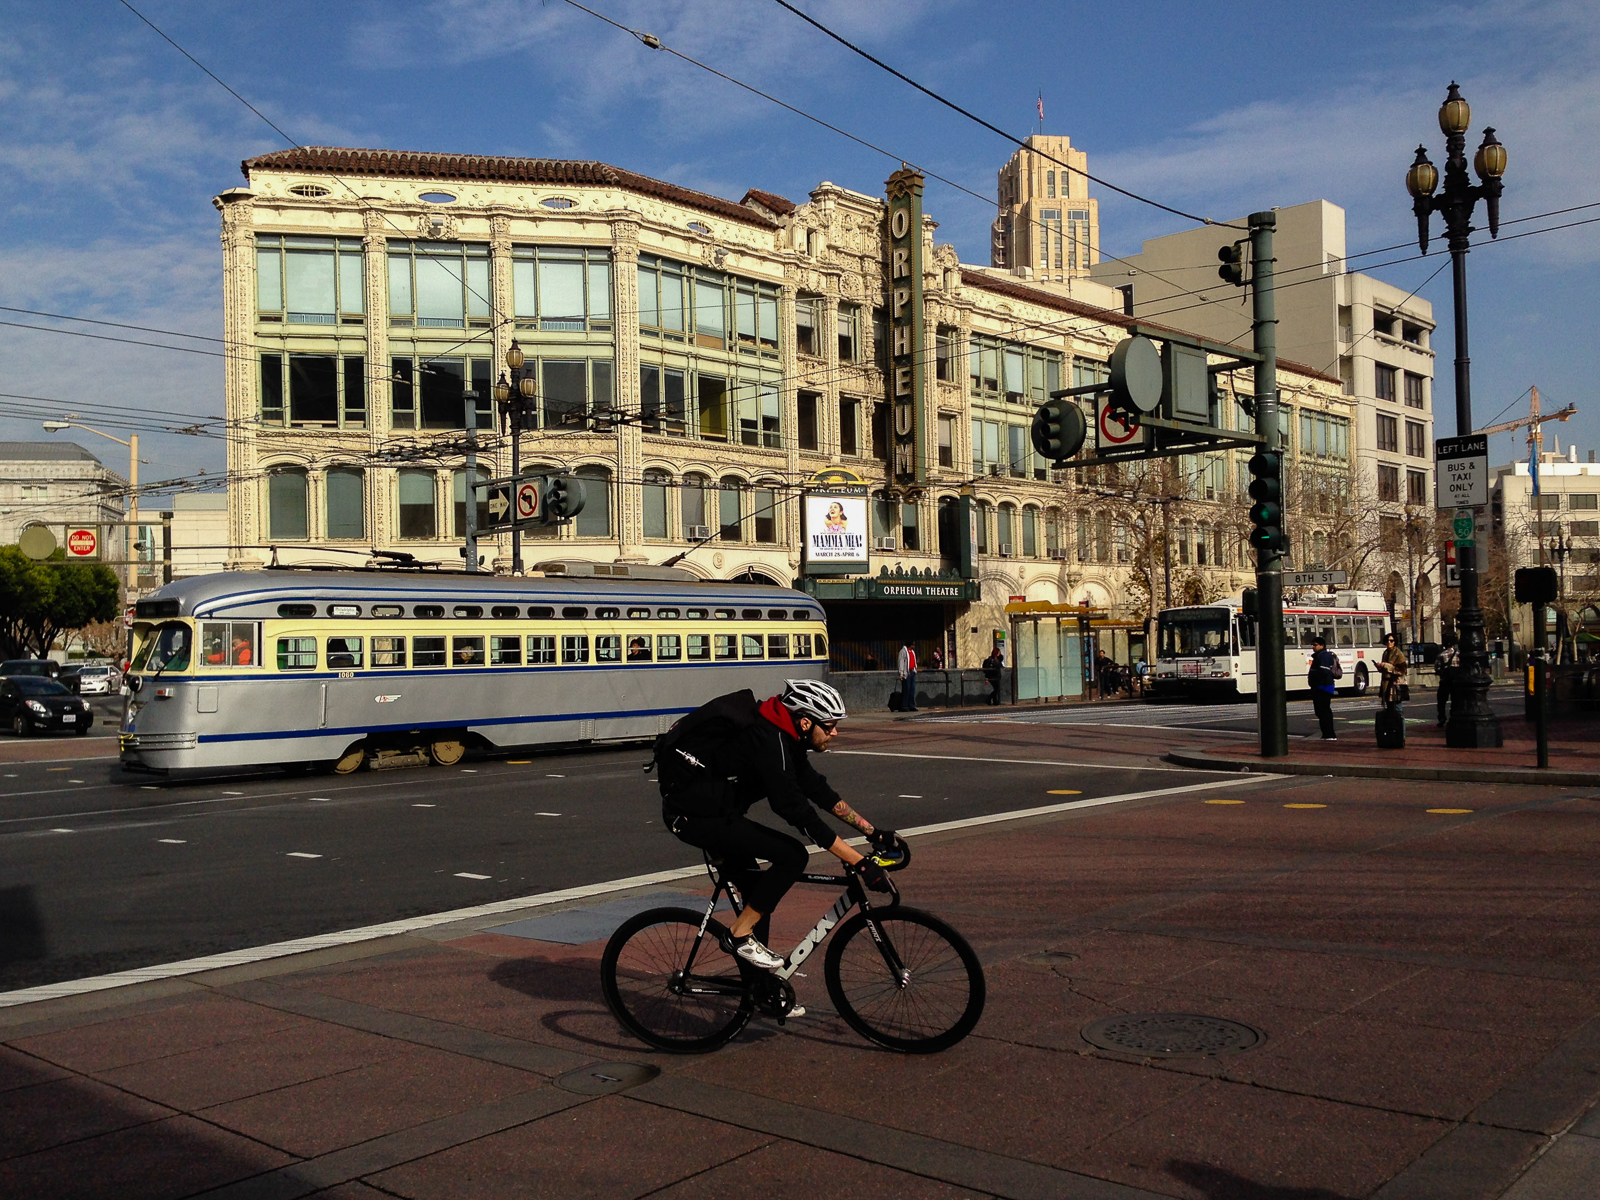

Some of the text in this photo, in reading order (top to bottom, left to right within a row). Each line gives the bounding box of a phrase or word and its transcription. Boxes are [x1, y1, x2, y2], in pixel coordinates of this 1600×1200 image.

[892, 207, 913, 474] ORPHEUM
[1437, 441, 1486, 455] LEFT LANE
[1447, 461, 1475, 472] BUS &
[1451, 472, 1472, 482] TAXI
[1449, 482, 1474, 493] ONLY
[1458, 528, 1470, 537] 50
[812, 534, 863, 548] MAMMA MIA!
[1295, 573, 1333, 583] 8TH ST
[883, 586, 959, 596] ORPHEUM THEATRE
